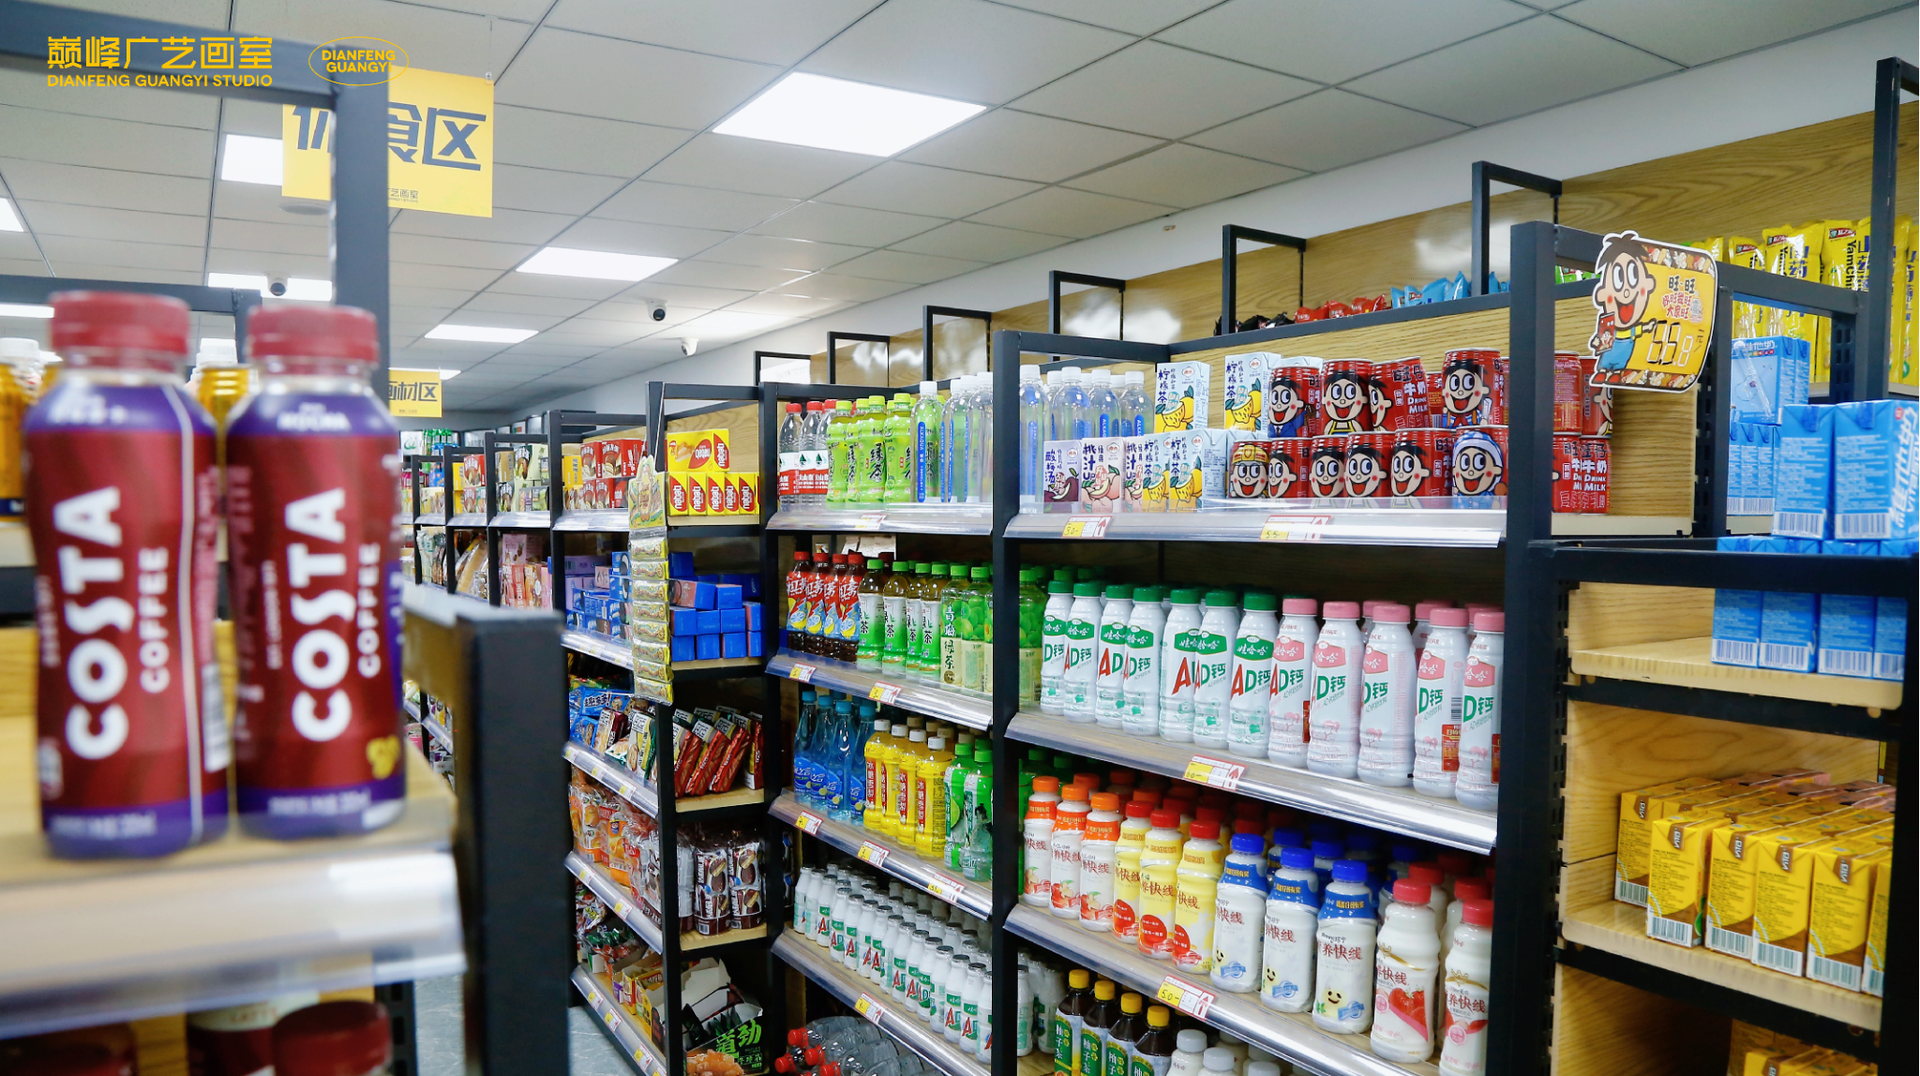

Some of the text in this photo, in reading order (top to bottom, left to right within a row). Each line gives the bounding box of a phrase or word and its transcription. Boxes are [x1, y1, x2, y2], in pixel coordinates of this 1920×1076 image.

[53, 486, 135, 760] COSTA
[138, 547, 170, 694] COFFEE
[284, 488, 356, 742] COSTA
[357, 543, 381, 679] COFFEE
[1230, 663, 1271, 701] AD钙
